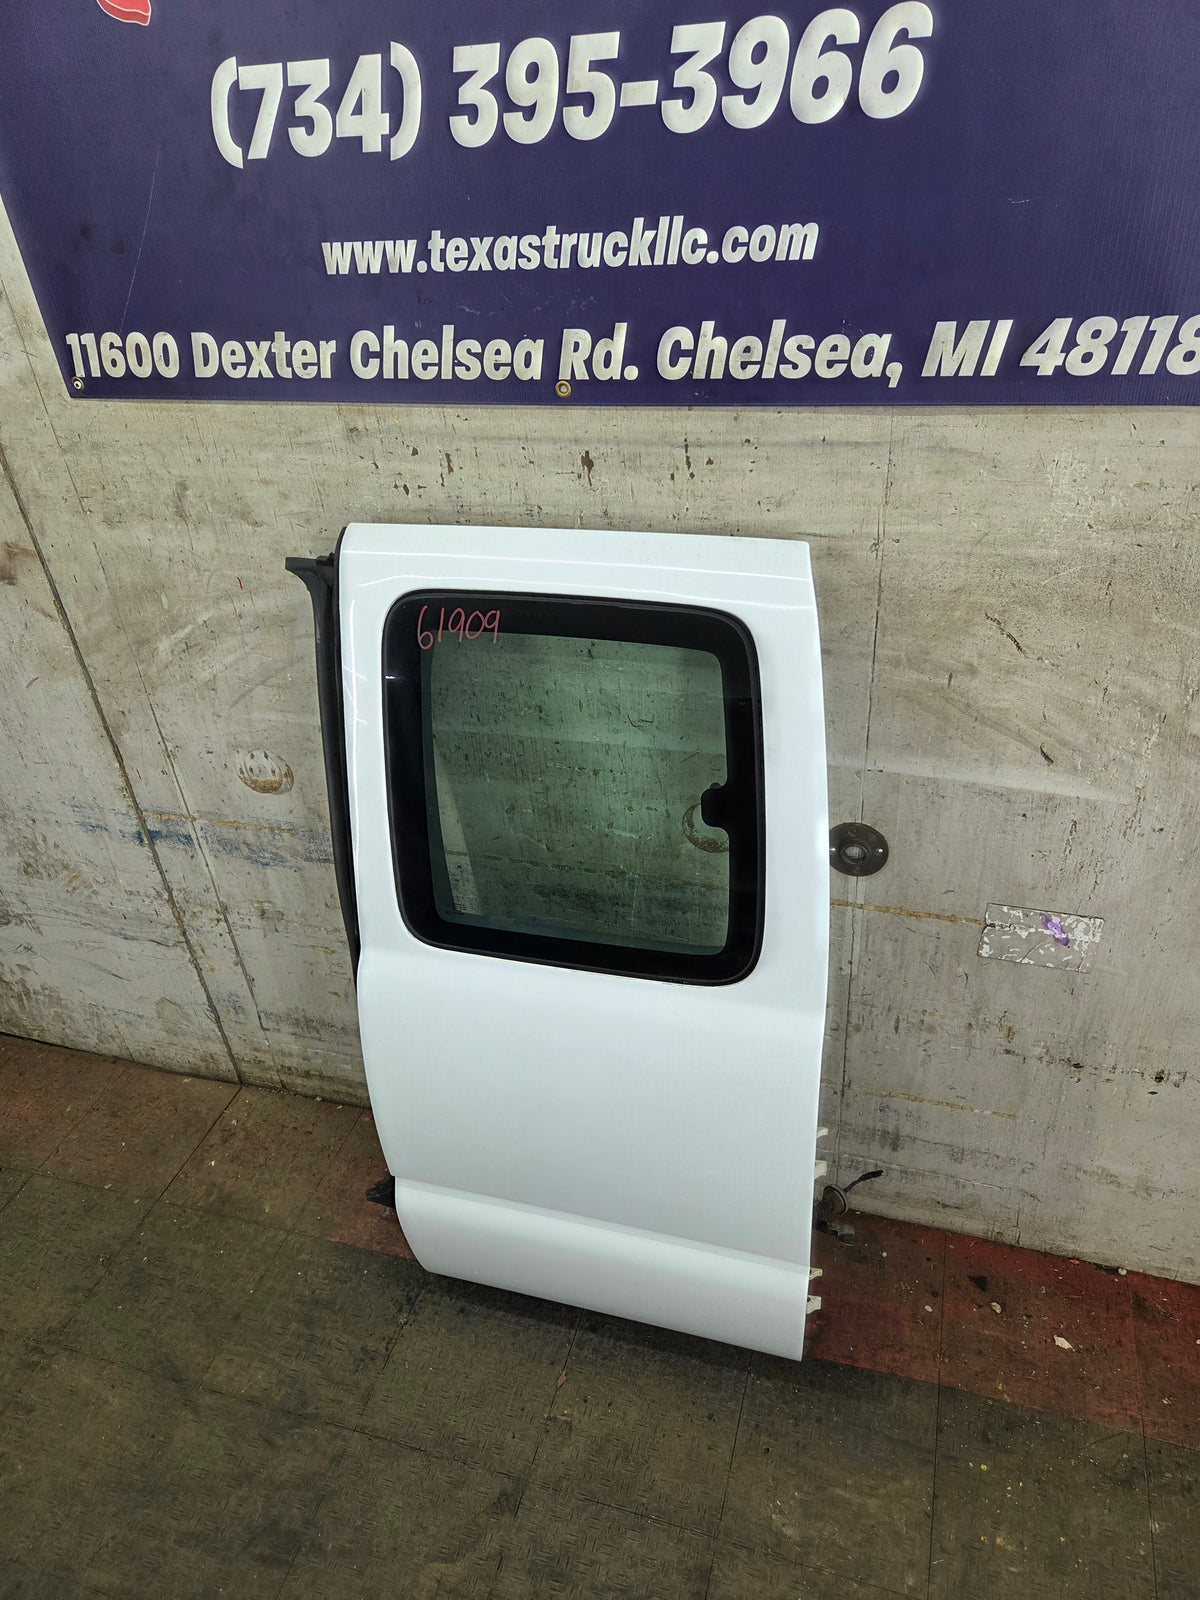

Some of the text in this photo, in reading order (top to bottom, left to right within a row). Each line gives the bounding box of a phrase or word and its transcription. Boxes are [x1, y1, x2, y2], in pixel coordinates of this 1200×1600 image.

[211, 1, 933, 169] (734) 395-3966
[321, 216, 819, 274] www.texastruckllc.com
[66, 314, 1200, 388] 11600 Dexter Chelsea Rd. Chelsea, MI 48118
[417, 605, 501, 650] 61909
